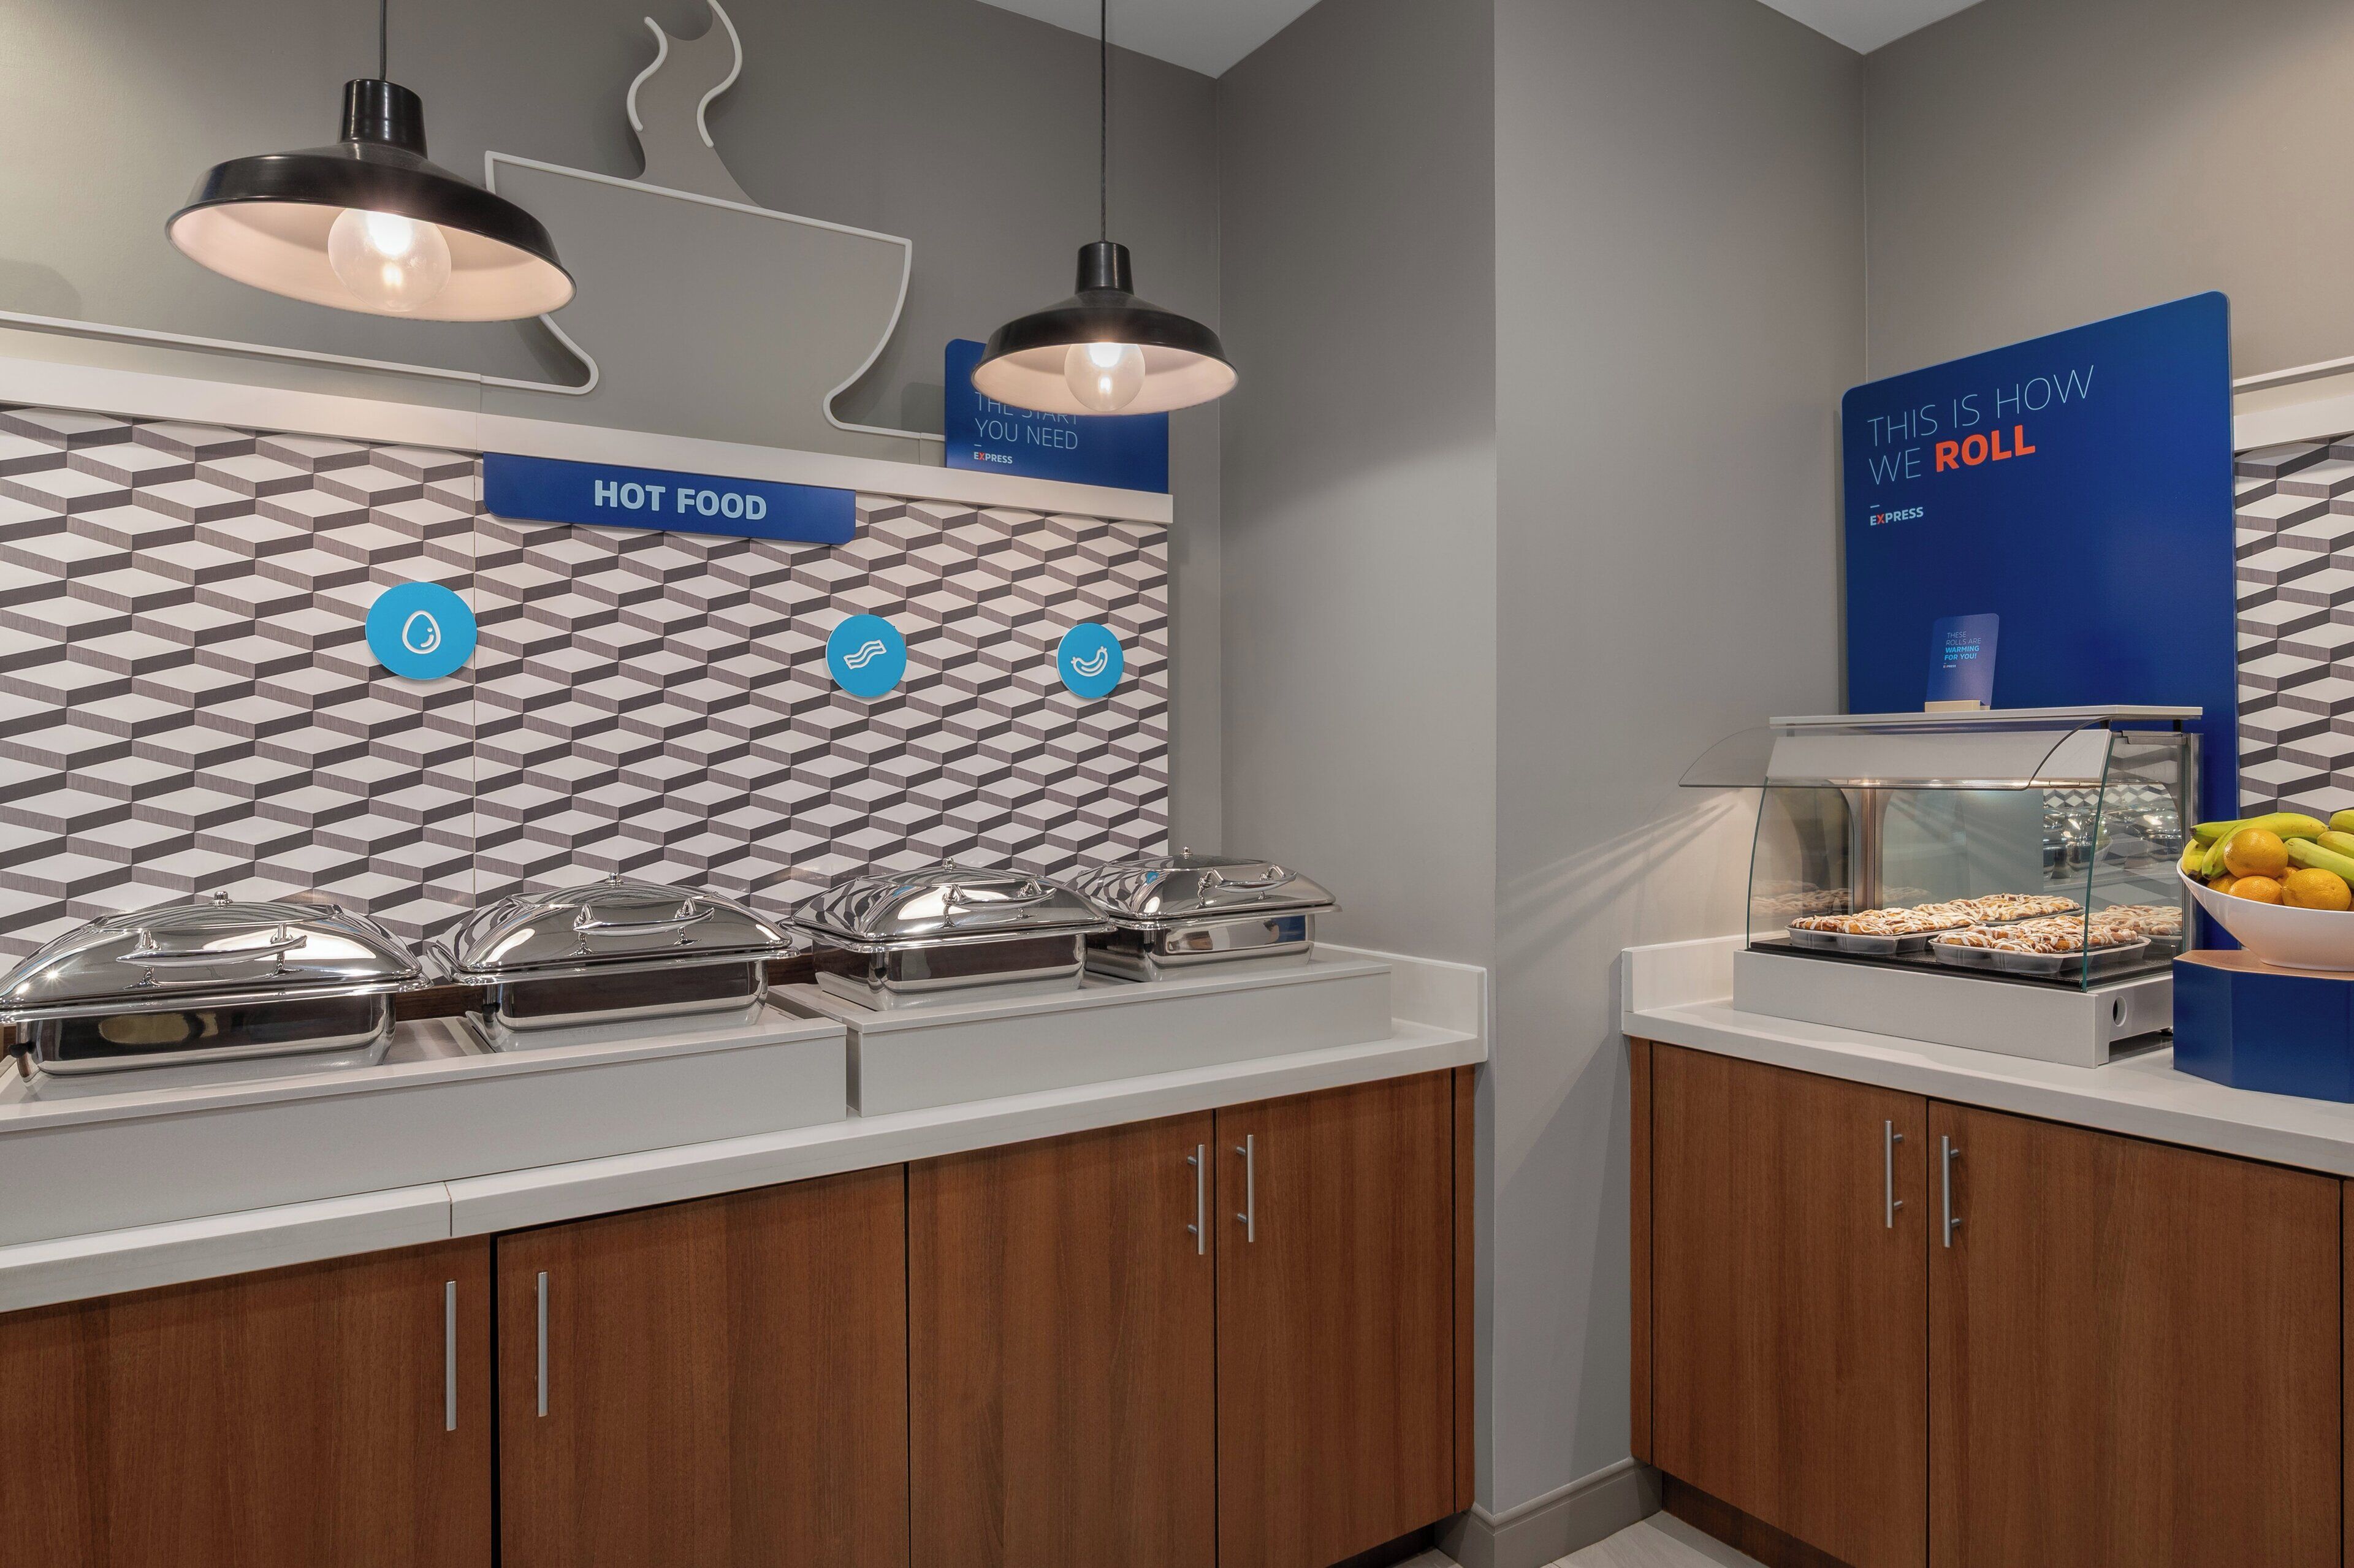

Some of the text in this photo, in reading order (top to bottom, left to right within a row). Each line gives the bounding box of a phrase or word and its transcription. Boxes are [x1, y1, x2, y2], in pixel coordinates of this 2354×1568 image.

[1867, 364, 2094, 446] THIS IS HOW
[974, 418, 1078, 450] YOU NEED
[973, 451, 1013, 464] EXPRESS
[1868, 424, 2036, 485] WE ROLL
[595, 479, 767, 520] HOT FOOD
[1870, 506, 1924, 526] EXPRESS
